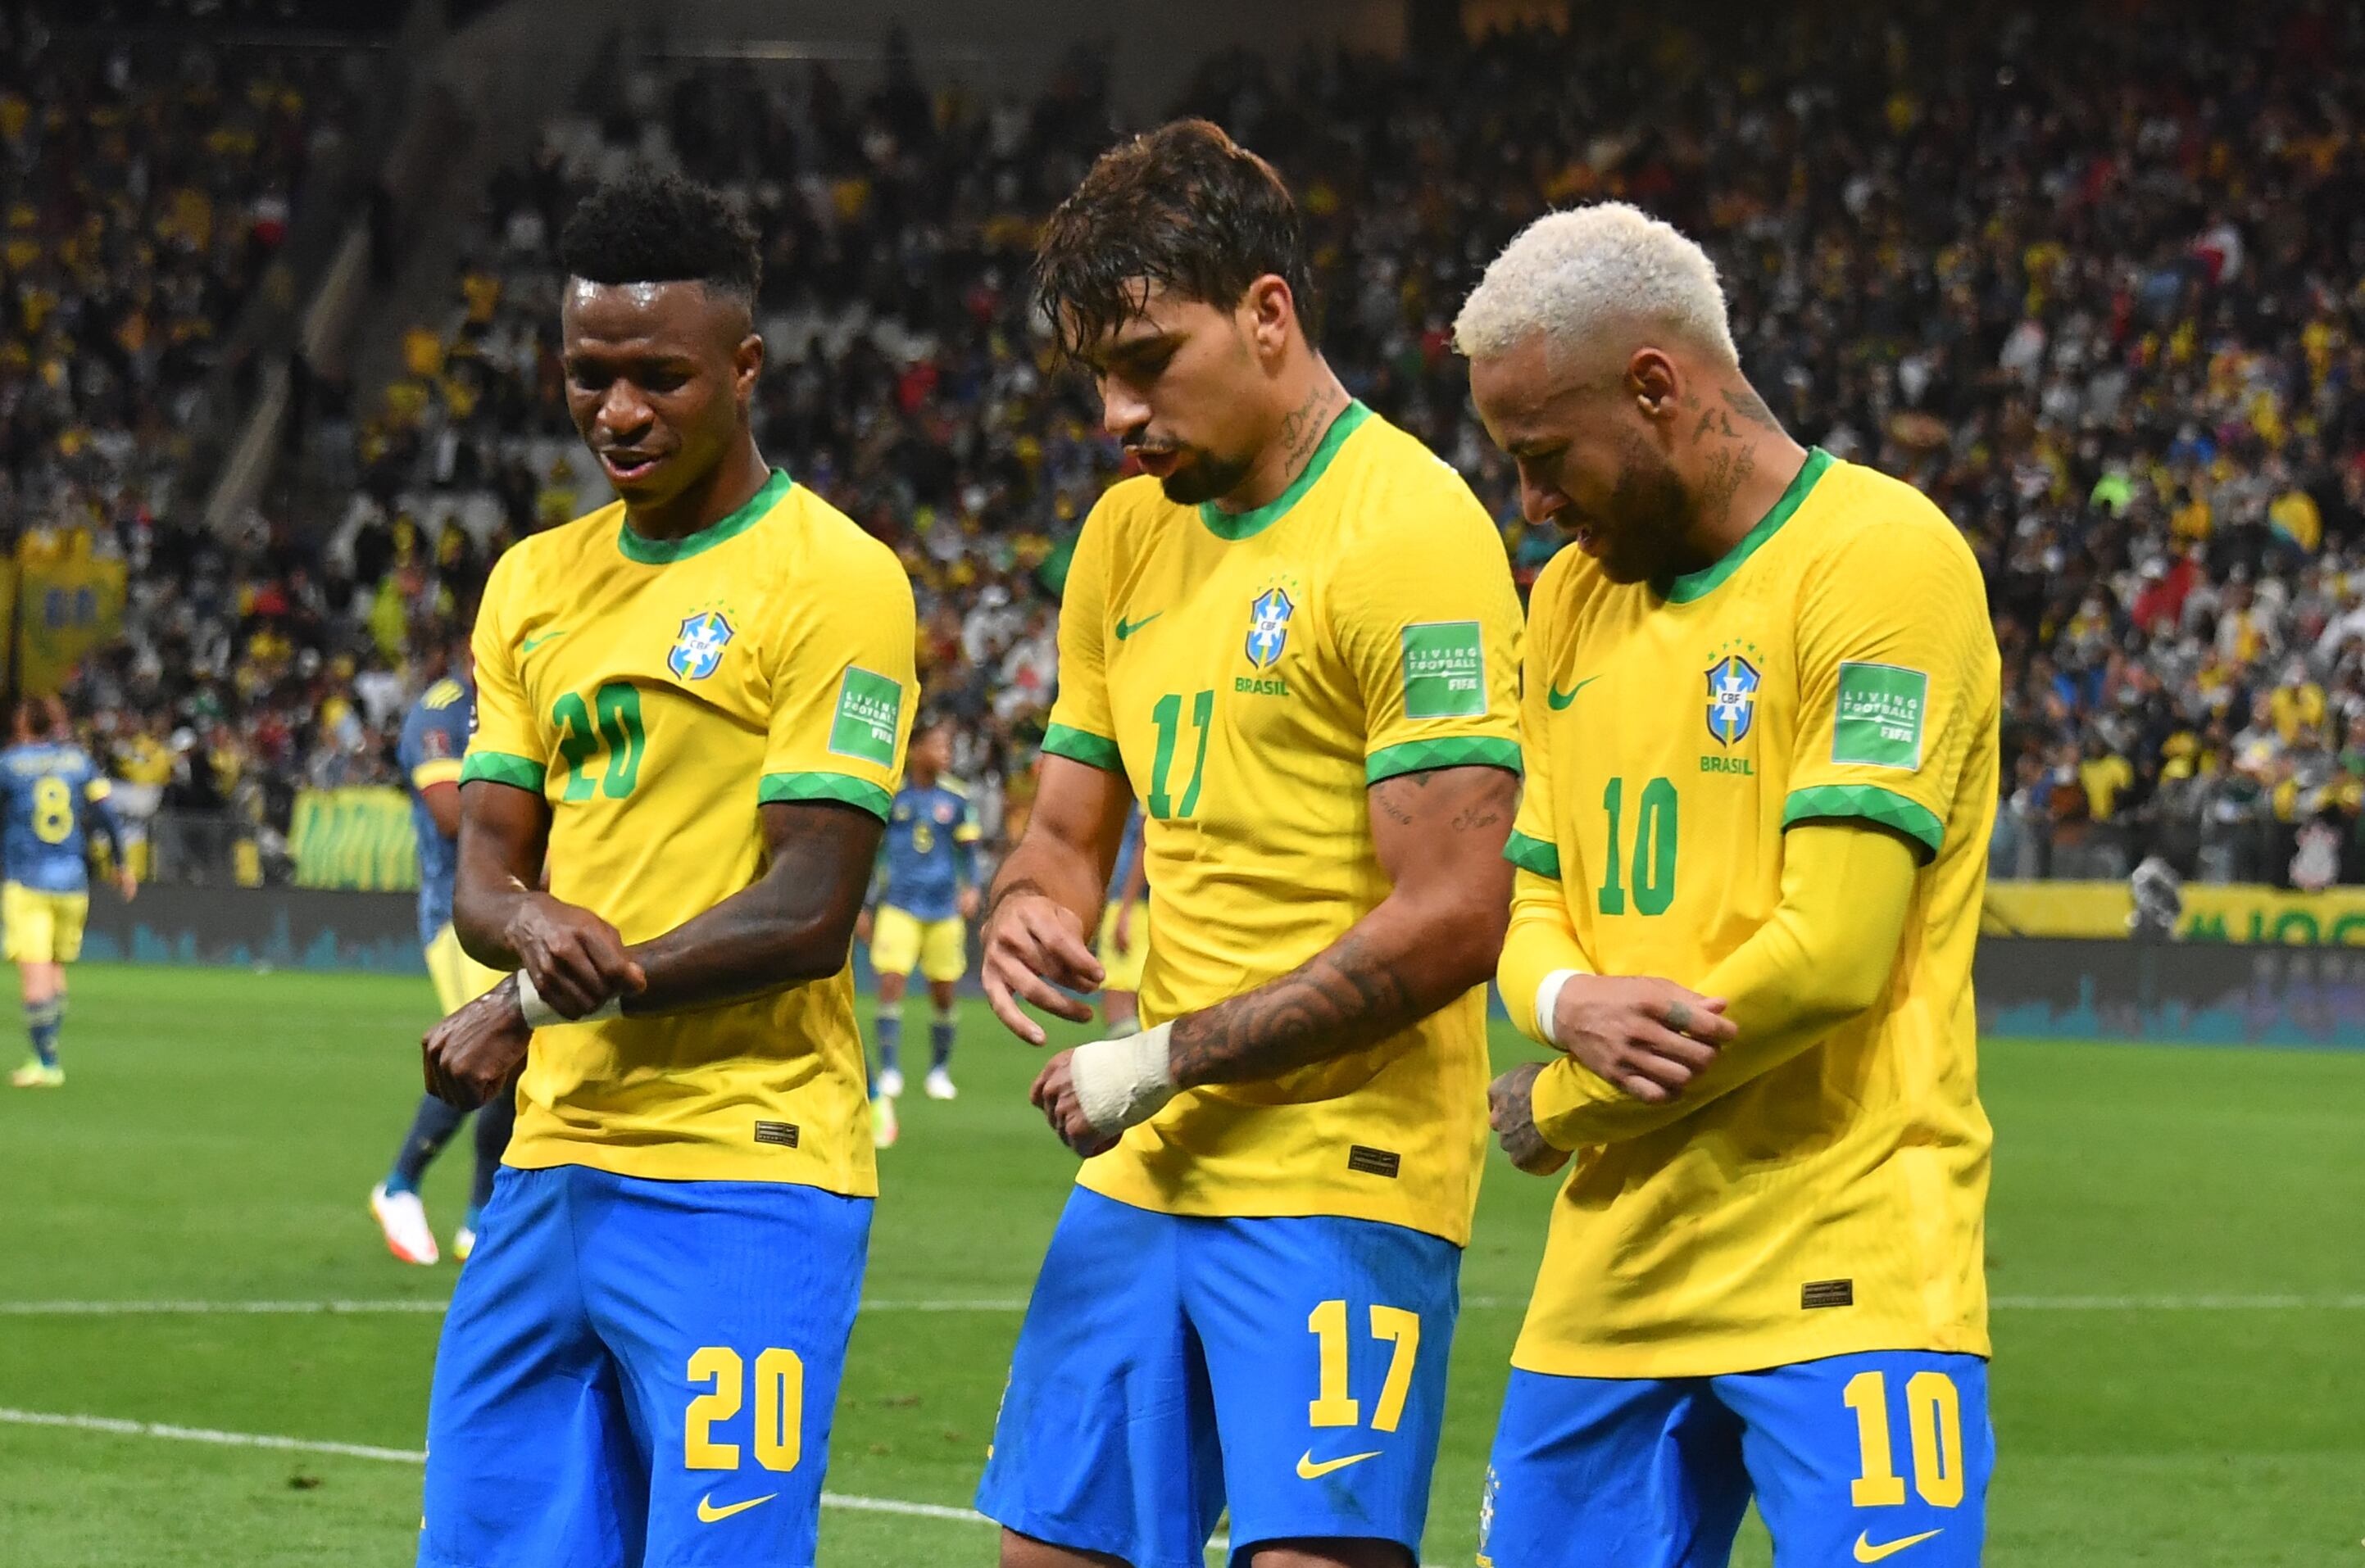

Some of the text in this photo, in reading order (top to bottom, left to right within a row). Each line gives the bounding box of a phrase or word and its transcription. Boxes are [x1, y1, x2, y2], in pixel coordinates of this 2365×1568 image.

[1260, 620, 1276, 631] CBF
[1409, 647, 1477, 659] LIVING
[1410, 658, 1477, 670] FOOTBALL
[1234, 677, 1290, 696] BRASIL
[1448, 678, 1477, 691] FIFA
[1721, 693, 1741, 704] CBF
[1844, 691, 1918, 709] LIVING
[1843, 701, 1915, 720] FOOTBALL
[552, 681, 647, 802] 20
[1880, 726, 1913, 743] FIFA
[1700, 755, 1754, 776] BRASIL
[32, 776, 75, 845] 8
[1597, 777, 1677, 916] 10
[1308, 1298, 1419, 1433] 17
[684, 1346, 803, 1472] 20
[1843, 1371, 1964, 1508] 10
